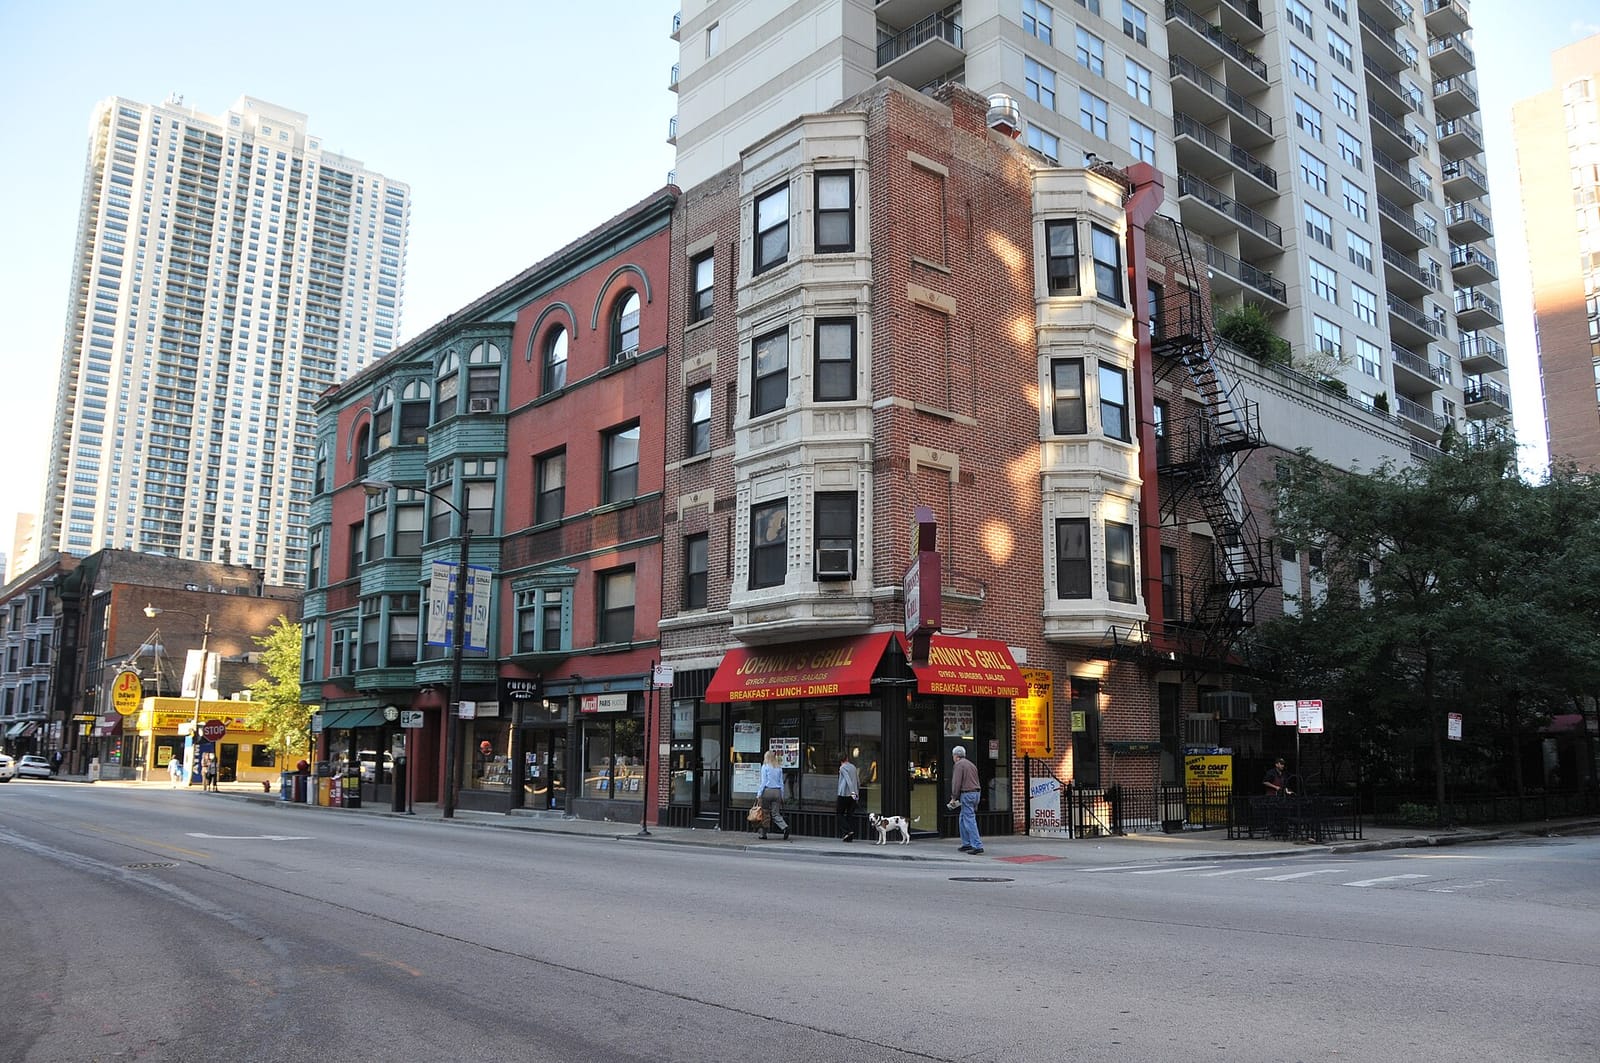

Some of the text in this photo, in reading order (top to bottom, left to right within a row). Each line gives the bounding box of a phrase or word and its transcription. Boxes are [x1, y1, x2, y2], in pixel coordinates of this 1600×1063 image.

[432, 600, 446, 616] 150
[474, 605, 487, 620] 150
[737, 648, 854, 675] JOHNNY'S GRILL
[928, 646, 1012, 670] HNNY'S GRILL
[745, 673, 828, 686] GYROS BURGERS SALADS
[938, 670, 1005, 681] GYROS BURGERS SALADS
[507, 681, 537, 693] europa
[730, 684, 839, 700] BREAKFAST LUNCH DINNER
[931, 683, 967, 693] BREAKFAST
[972, 685, 992, 694] LUNCH
[997, 686, 1019, 696] DINNER
[599, 698, 611, 707] PARIS
[204, 725, 225, 735] STOP
[1031, 781, 1055, 796] HARRY'S
[1035, 809, 1056, 818] SHOE
[1031, 818, 1060, 828] REPAIRS
